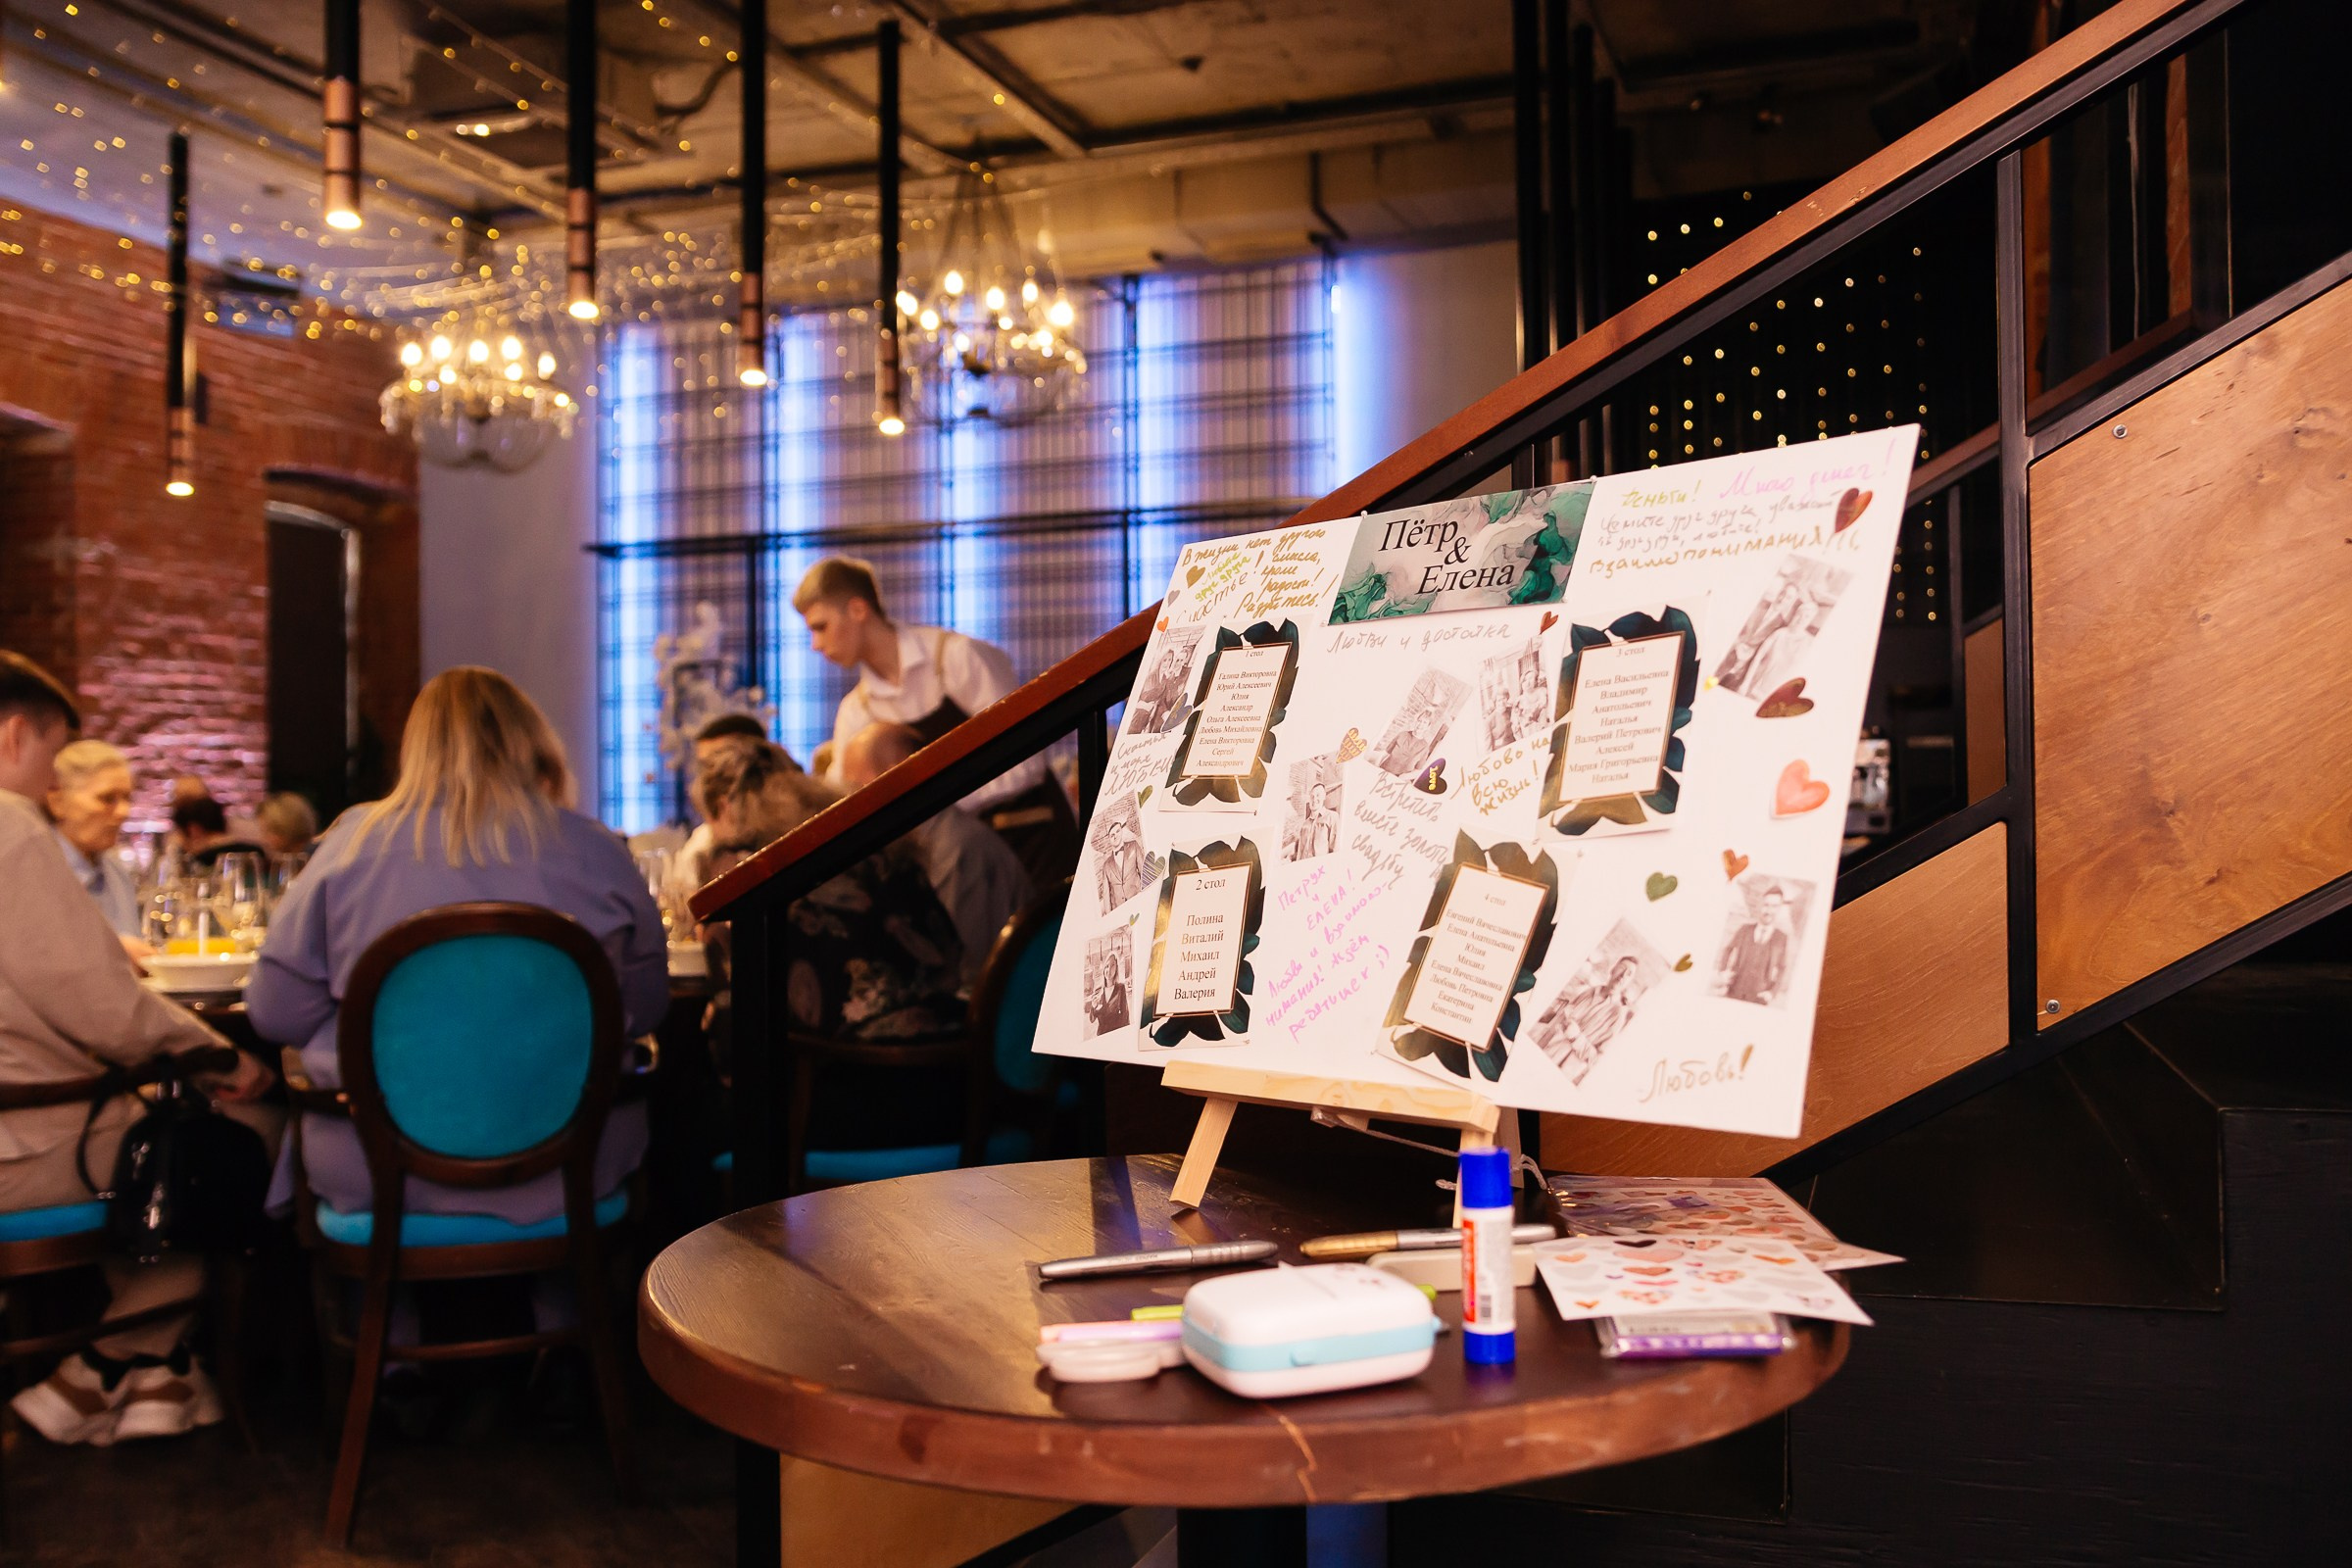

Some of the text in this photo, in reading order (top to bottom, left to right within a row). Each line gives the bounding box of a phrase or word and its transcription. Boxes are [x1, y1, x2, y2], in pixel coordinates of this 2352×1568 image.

[1246, 538, 1272, 550] нет
[1273, 528, 1326, 554] другого
[1378, 518, 1459, 553] Пётр
[1445, 536, 1472, 565] &
[1415, 564, 1516, 595] Елена
[1624, 647, 1644, 657] стол
[1219, 670, 1277, 680] Галина Викторовна
[1585, 669, 1669, 689] Елена Васильевна
[1216, 683, 1235, 692] Юрий
[1599, 686, 1647, 700] Владимир
[1592, 699, 1651, 714] Анатольевич
[1206, 715, 1224, 724] Ольга
[1600, 715, 1639, 727] Наталья
[1574, 726, 1661, 745] Валерий Петрович
[1211, 748, 1234, 757] Сергей
[1595, 742, 1634, 755] Алексей
[1569, 755, 1658, 773] Мария Григорьевна
[1592, 772, 1629, 784] Наталья
[1196, 879, 1225, 890] 2 стол
[1186, 914, 1224, 926] Полина
[1446, 909, 1527, 940] Евгений Вячеславович
[1181, 930, 1224, 945] Виталий
[1446, 923, 1515, 953] Елена Анатольевна
[1180, 951, 1219, 962] Михаил
[1464, 943, 1487, 957] Юлия
[1457, 955, 1486, 970] Михаил
[1178, 968, 1216, 982] Андрей
[1431, 959, 1503, 992] Елена Вячеславовна
[1174, 988, 1215, 1001] Валерия
[1431, 974, 1494, 1003] Любовь Петровна
[1438, 991, 1475, 1010] Екатерина
[1431, 1003, 1472, 1024] Константин
